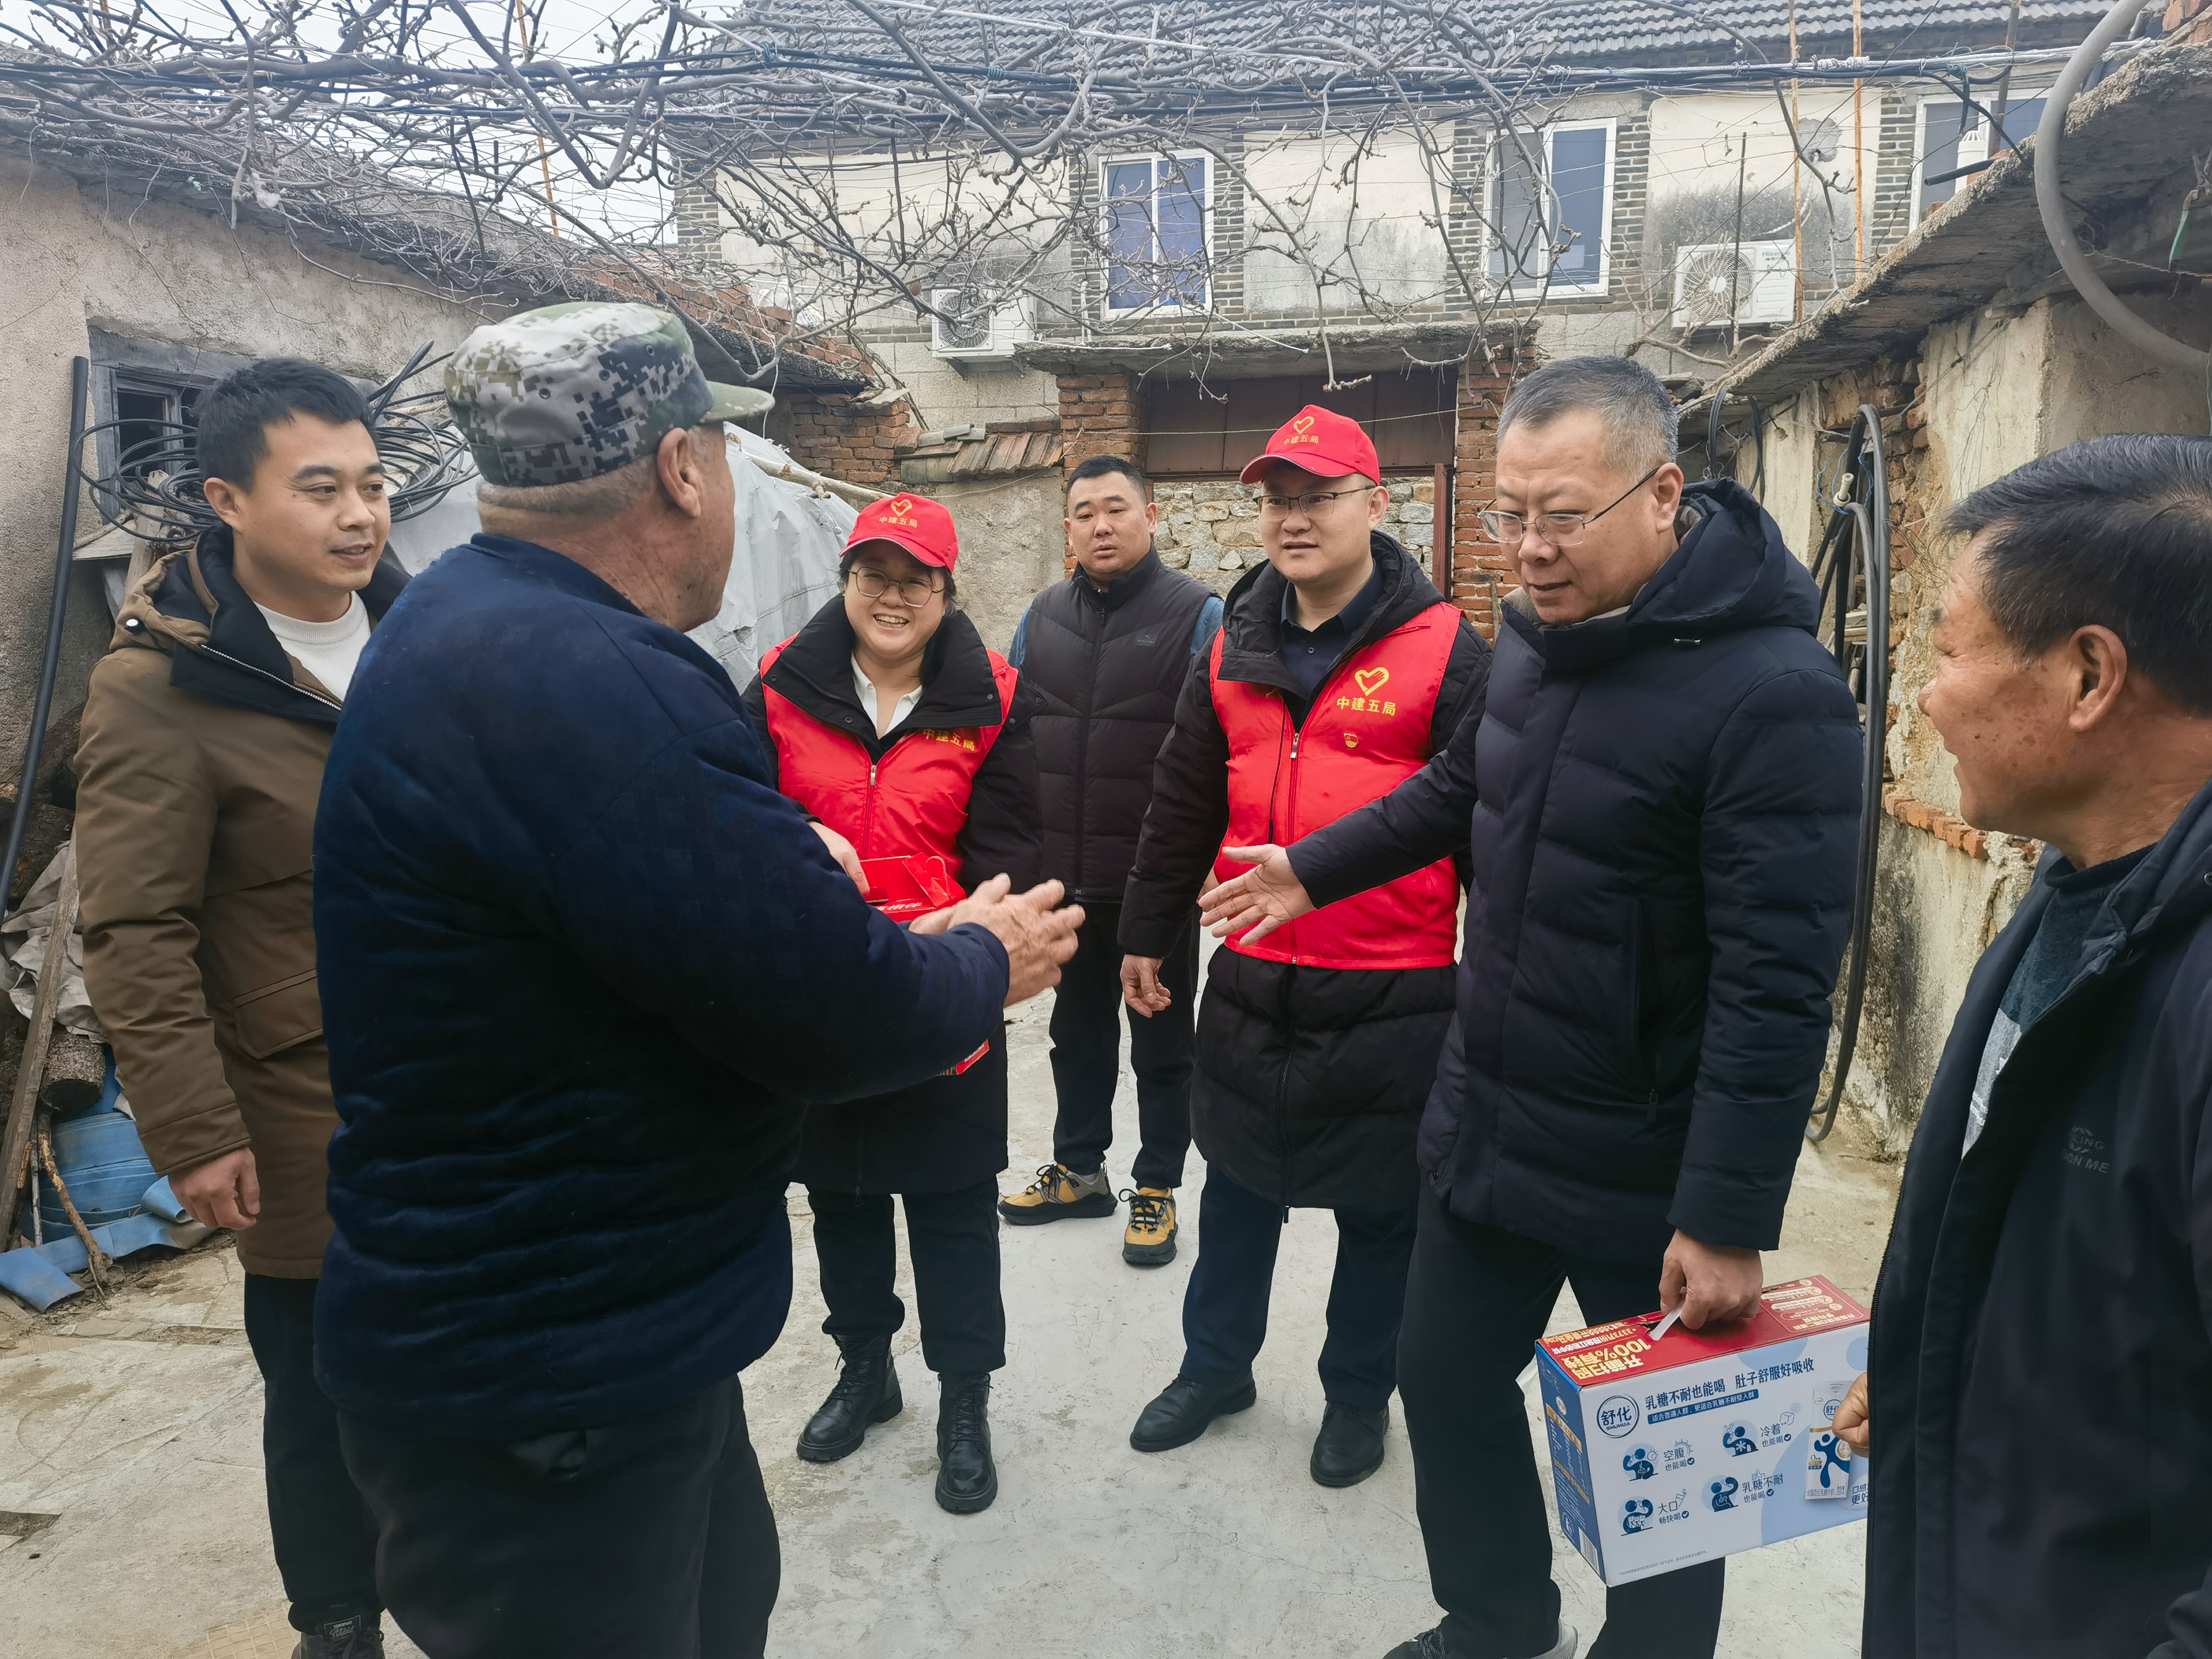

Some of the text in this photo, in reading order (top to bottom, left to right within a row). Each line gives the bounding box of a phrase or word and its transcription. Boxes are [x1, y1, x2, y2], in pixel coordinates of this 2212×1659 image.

[1283, 434, 1319, 446] 中建五局
[878, 516, 918, 529] 中建五局
[1336, 695, 1397, 717] 中建五局
[922, 727, 975, 752] 中建五局
[1561, 1338, 1651, 1370] 100%有钱
[1571, 1354, 1644, 1380] 开箱扫码
[1645, 1357, 1815, 1410] 乳糖不耐也能喝 肚子舒服好吸收
[1601, 1406, 1632, 1426] 舒化
[1606, 1421, 1631, 1431] SHUHUA
[1759, 1423, 1782, 1438] 冷着
[1762, 1436, 1783, 1447] 也能喝
[1663, 1447, 1685, 1462] 空腹
[1665, 1459, 1687, 1471] 也能喝
[1742, 1473, 1783, 1493] 乳糖不耐
[1743, 1491, 1765, 1503] 也能喝
[1657, 1501, 1678, 1515] 大口
[1658, 1513, 1681, 1525] 畅快喝
